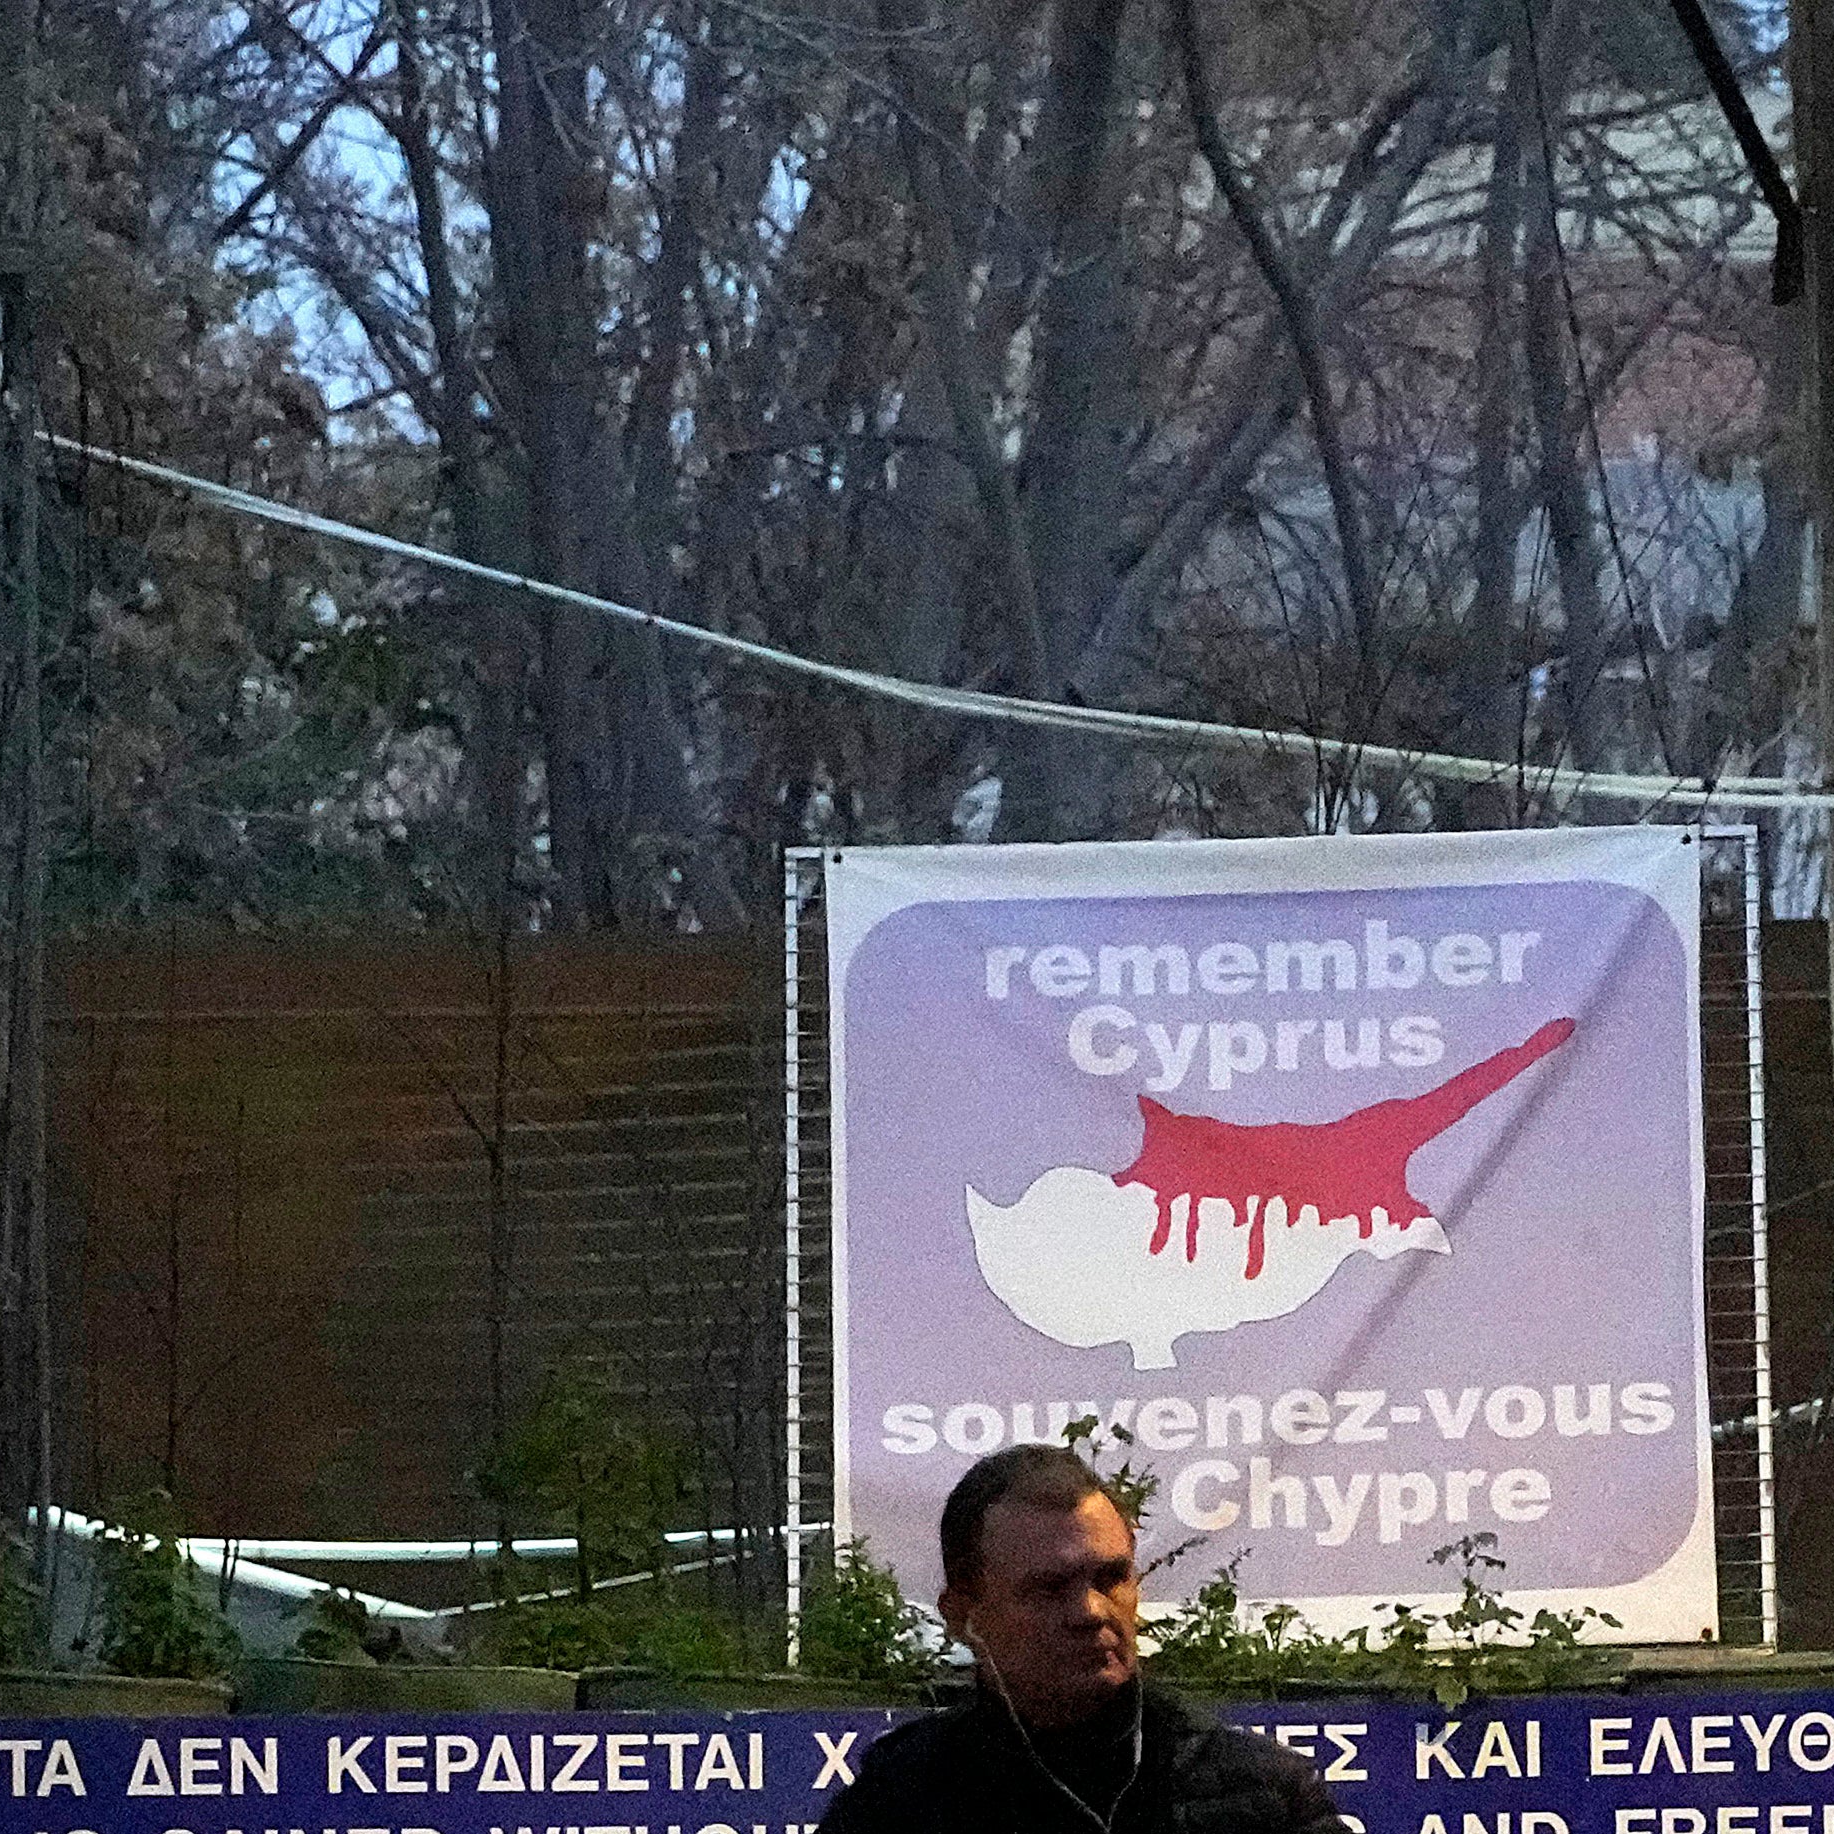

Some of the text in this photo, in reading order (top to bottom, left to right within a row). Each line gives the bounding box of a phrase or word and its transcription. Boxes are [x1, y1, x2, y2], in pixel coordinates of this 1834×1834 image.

[985, 919, 1540, 1000] remember
[1068, 1004, 1445, 1091] Cyprus
[881, 1381, 1675, 1454] souvenez-vous
[1171, 1458, 1551, 1546] Chypre
[127, 1737, 278, 1796] ΔΕΝ
[328, 1733, 763, 1794] ΚΕΡΔΙΖΕΤΑΙ
[1415, 1721, 1541, 1780] ΚΑΙ
